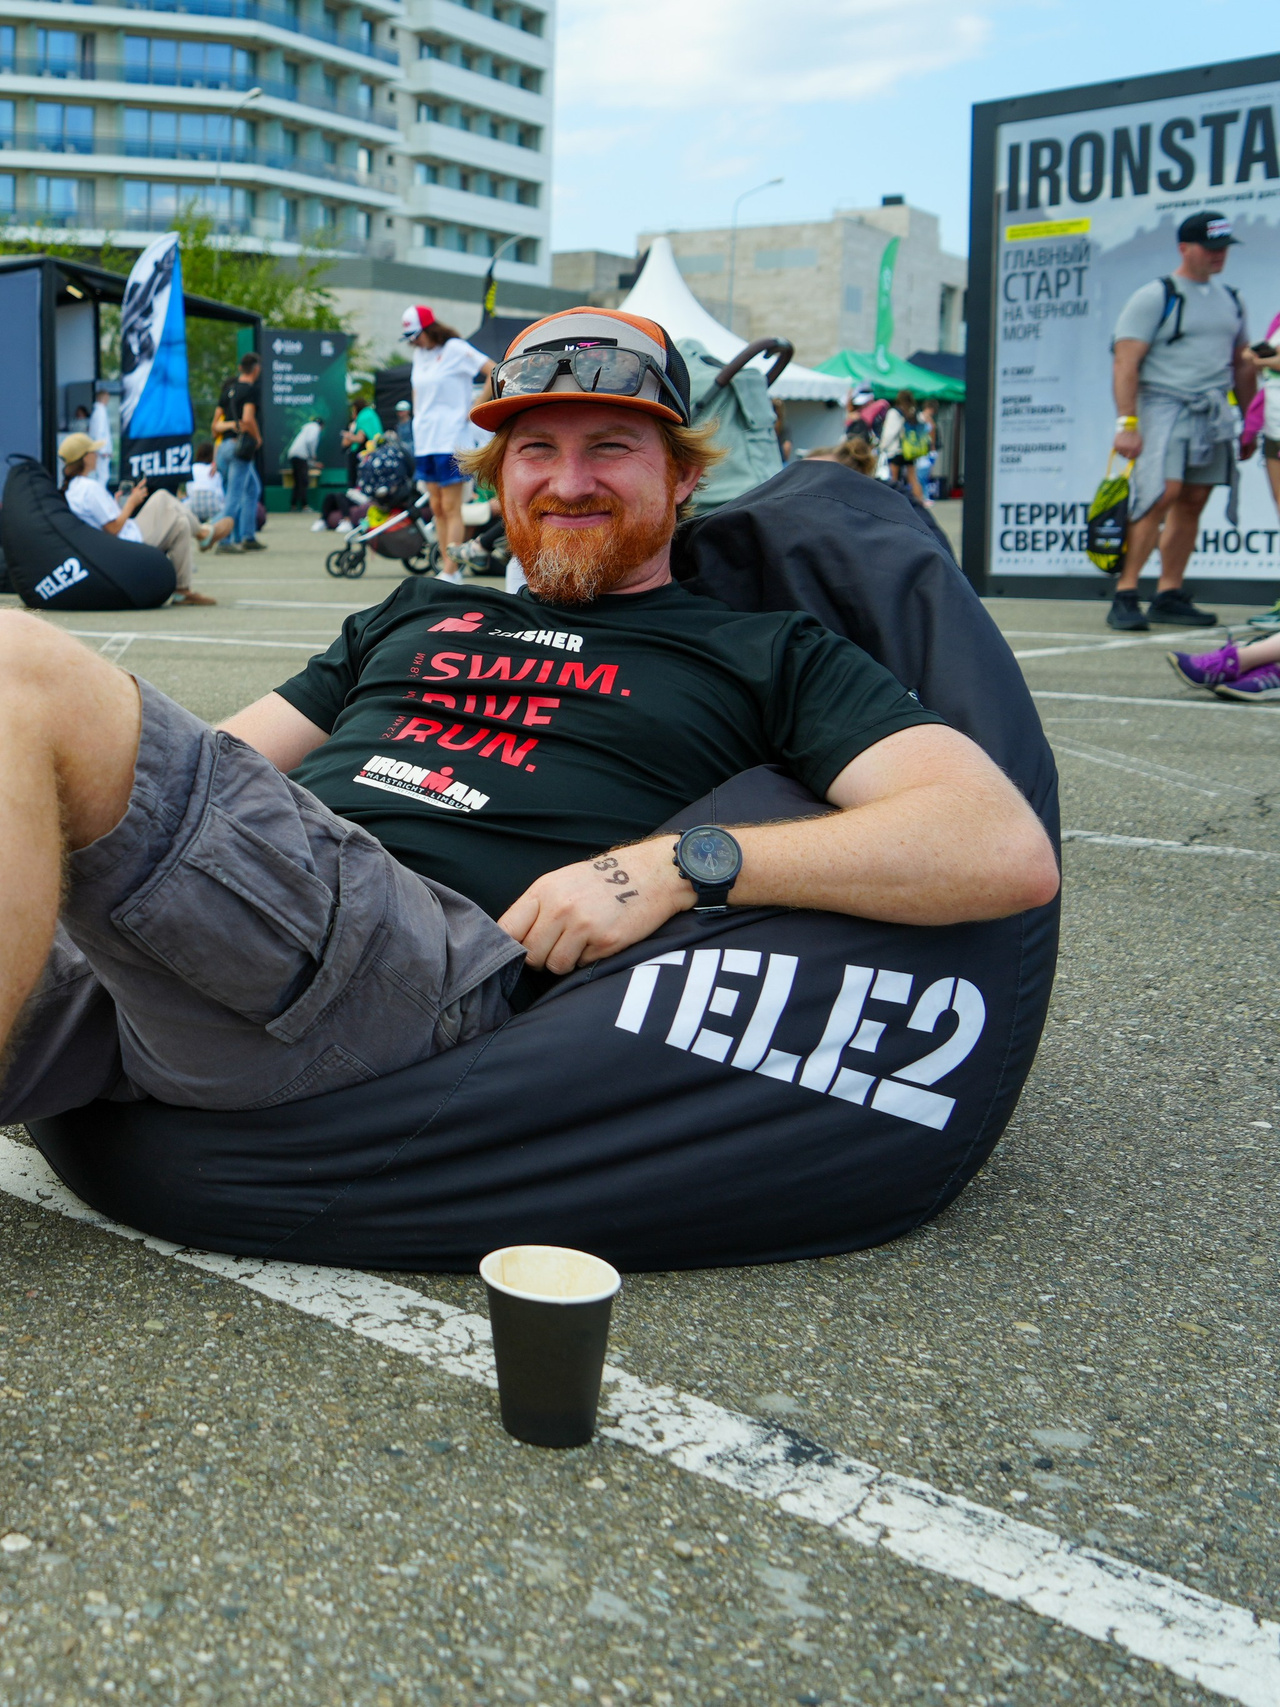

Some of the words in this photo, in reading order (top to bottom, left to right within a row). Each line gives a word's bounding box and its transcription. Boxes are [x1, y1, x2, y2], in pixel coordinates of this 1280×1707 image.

[1006, 104, 1280, 212] IRONSTA
[1004, 238, 1091, 270] ГЛАВНЫЙ
[1003, 265, 1088, 303] СТАРТ
[1003, 323, 1040, 341] МОРЕ
[129, 443, 193, 478] TELE2
[34, 557, 89, 600] TELE2
[422, 651, 631, 697] SWIM.
[392, 717, 539, 773] RUN.
[362, 754, 491, 810] IRONMAN
[365, 772, 425, 793] MAASTRICHT
[615, 948, 986, 1131] TELE2
